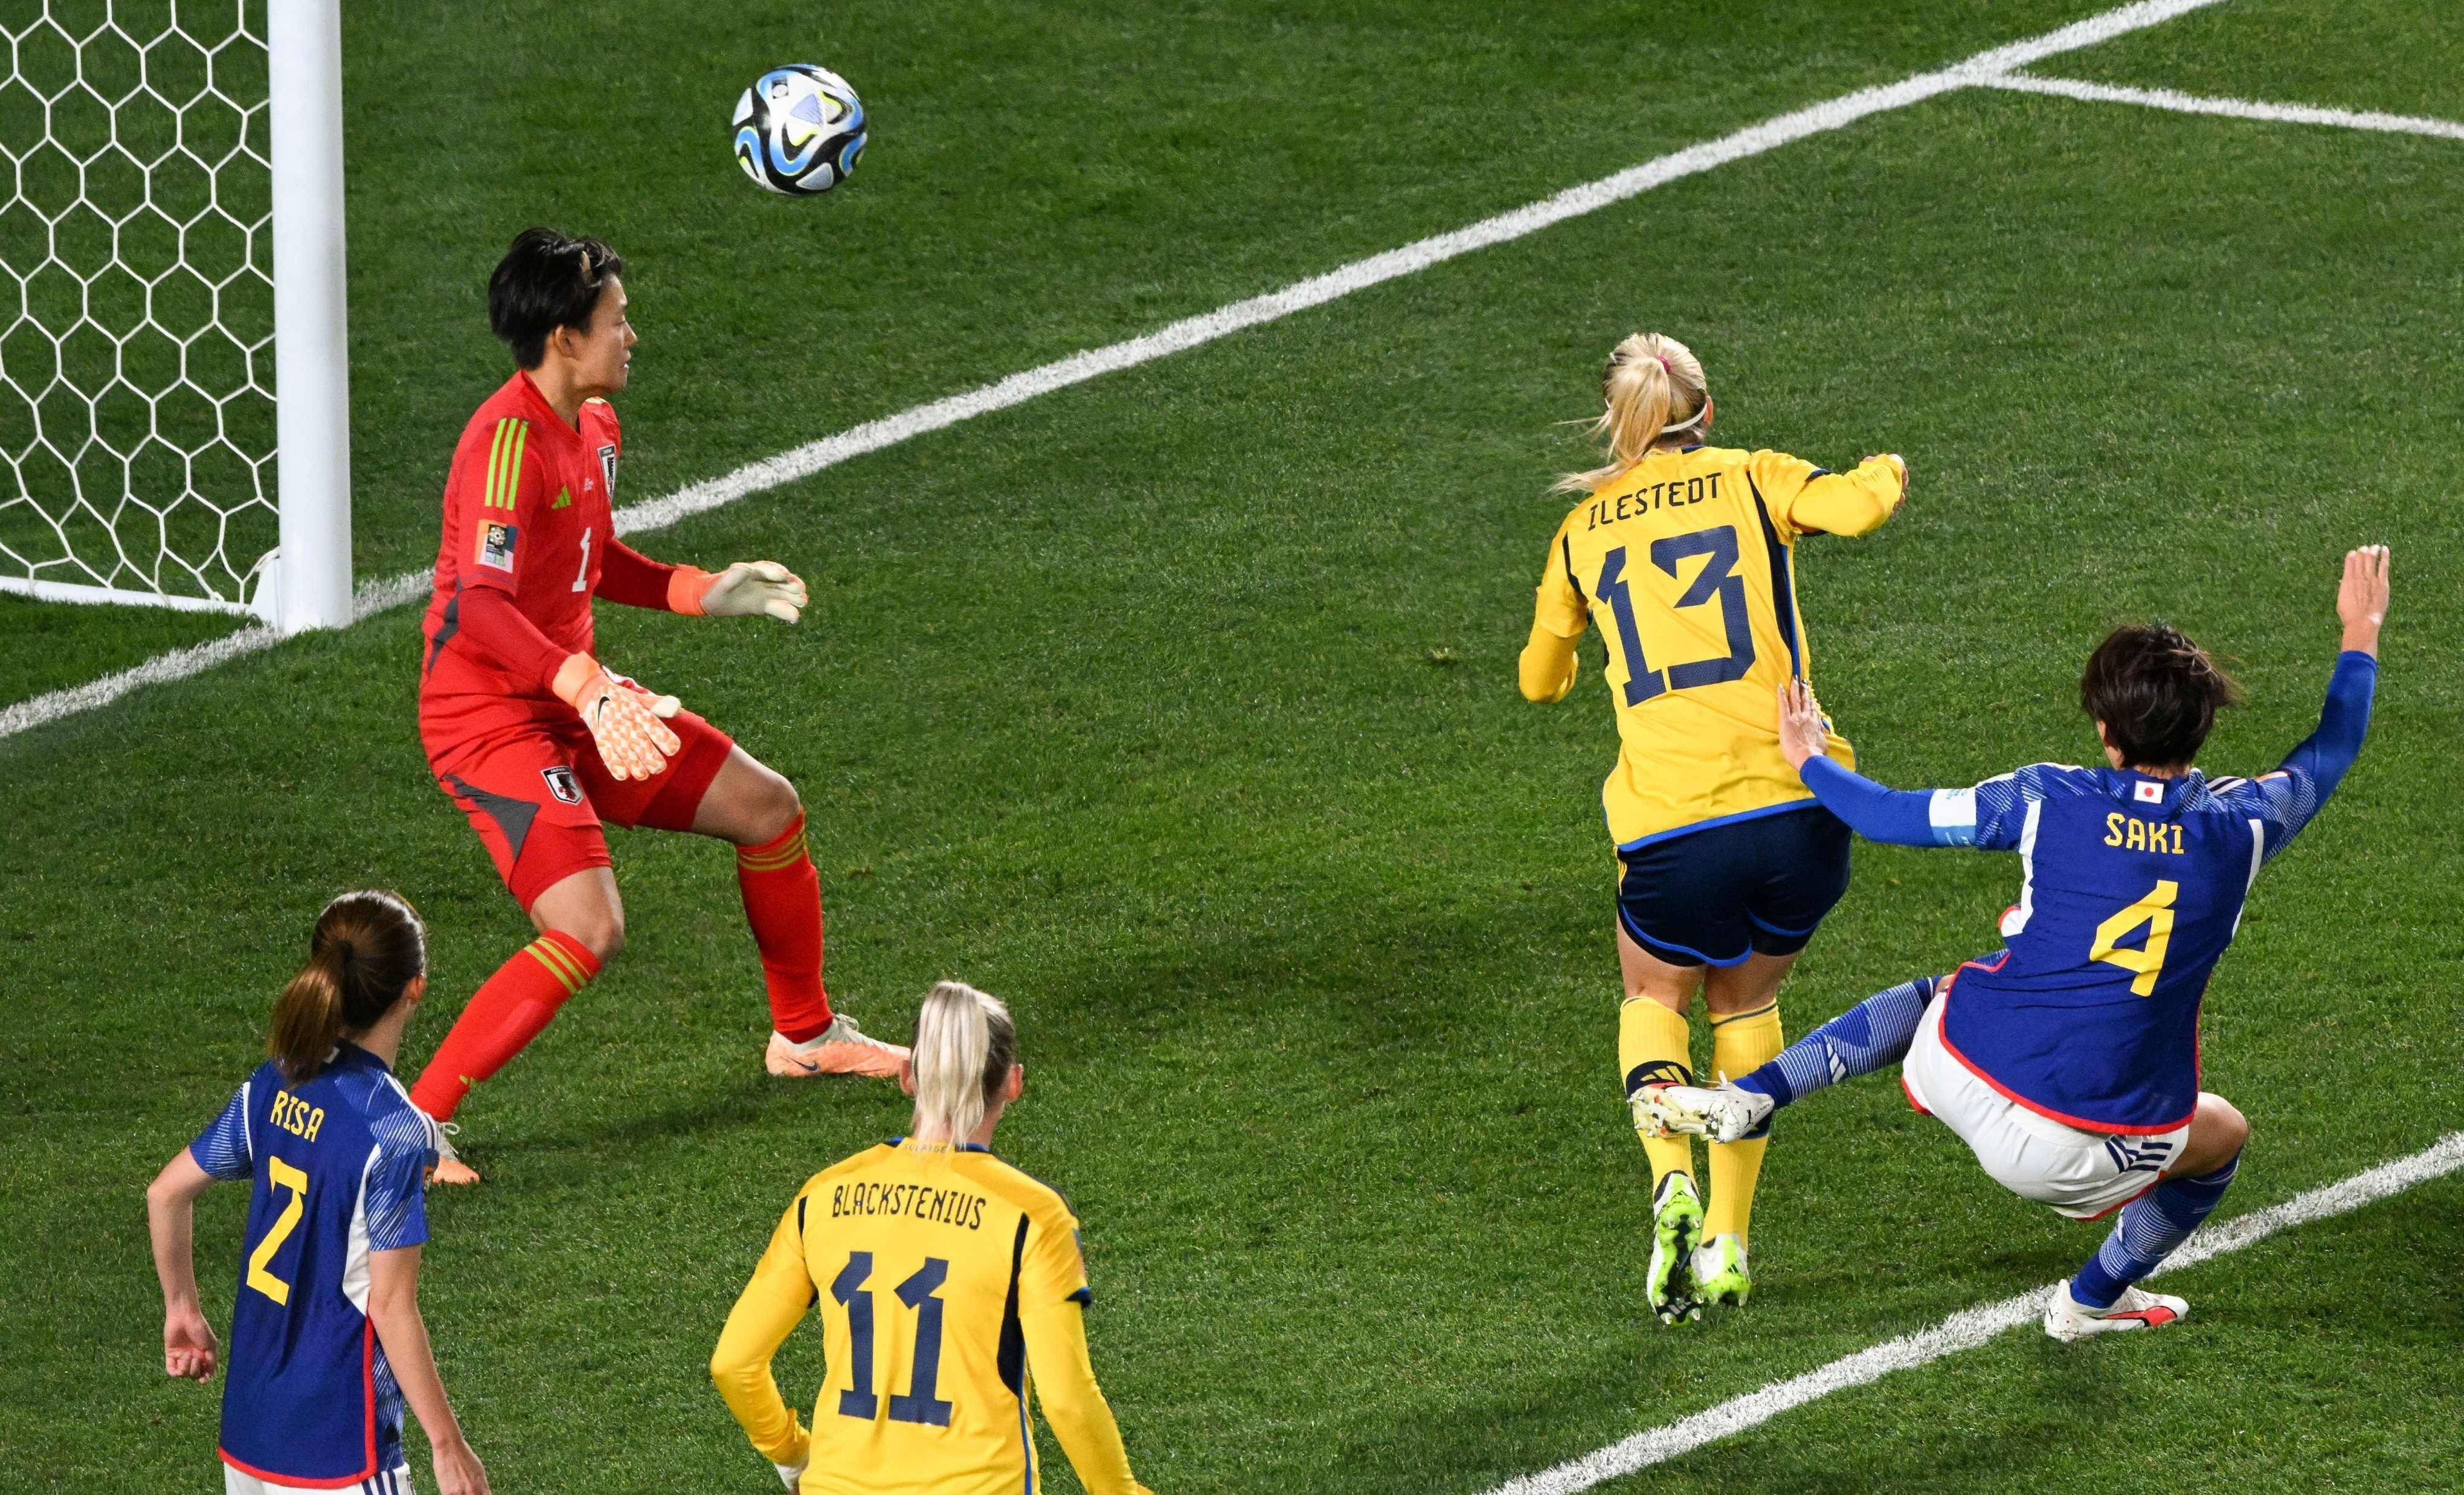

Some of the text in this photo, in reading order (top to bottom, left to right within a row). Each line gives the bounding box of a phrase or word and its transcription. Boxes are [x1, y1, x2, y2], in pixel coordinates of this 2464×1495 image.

[1588, 472, 1722, 532] ILESTEDT
[571, 527, 591, 592] 1
[1595, 524, 1756, 707] 13
[2104, 812, 2184, 854] SAKI
[2089, 879, 2178, 997] 4
[270, 1090, 324, 1143] RISA
[246, 1155, 307, 1306] 2
[832, 1183, 986, 1230] BLACKSTENIUS
[830, 1250, 953, 1427] 11
